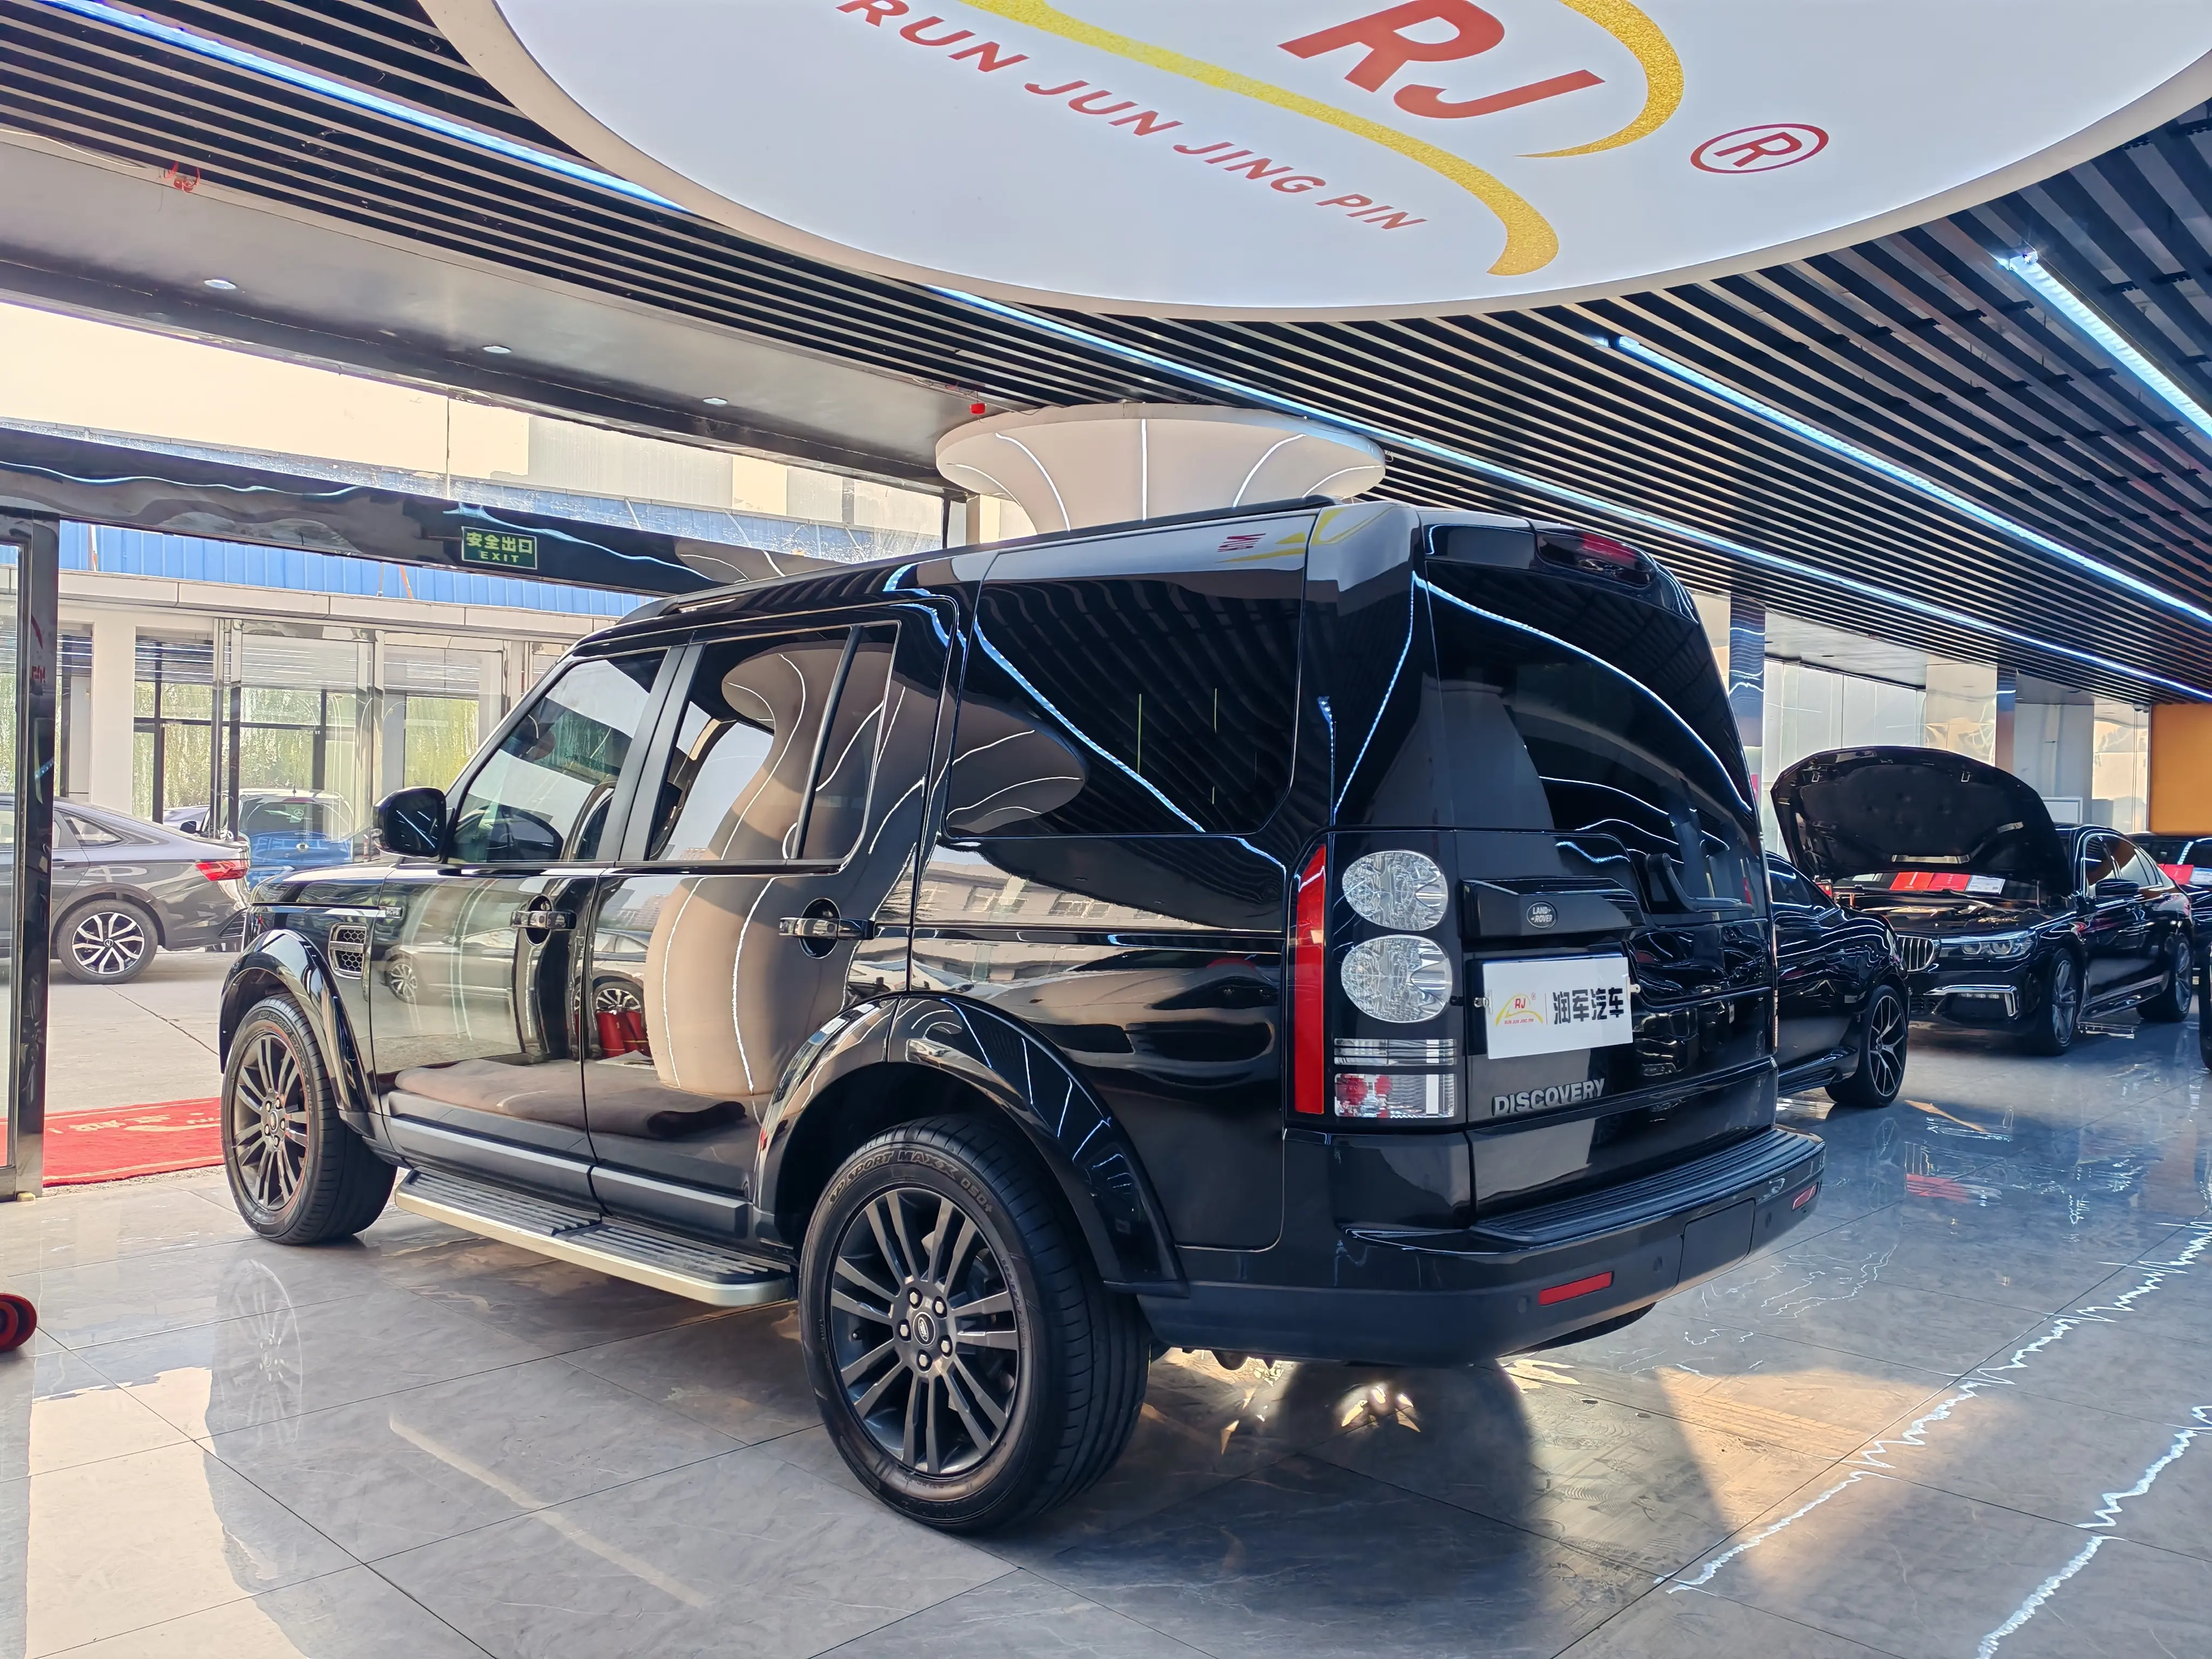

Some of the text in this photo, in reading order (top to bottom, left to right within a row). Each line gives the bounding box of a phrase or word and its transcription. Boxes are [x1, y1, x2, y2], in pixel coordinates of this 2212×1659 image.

[1278, 0, 1606, 118] RJ
[836, 0, 1427, 230] RUN JUN JING PIN
[466, 531, 532, 555] 安全出口
[480, 550, 519, 563] EXIT
[1533, 906, 1548, 915] LAND
[1534, 914, 1553, 923] ROVER
[1515, 998, 1526, 1009] RJ
[1552, 987, 1624, 1025] 润军汽车
[1492, 1078, 1605, 1116] DISCOVERY
[846, 1150, 894, 1184] SPORT
[897, 1149, 960, 1181] MAXX
